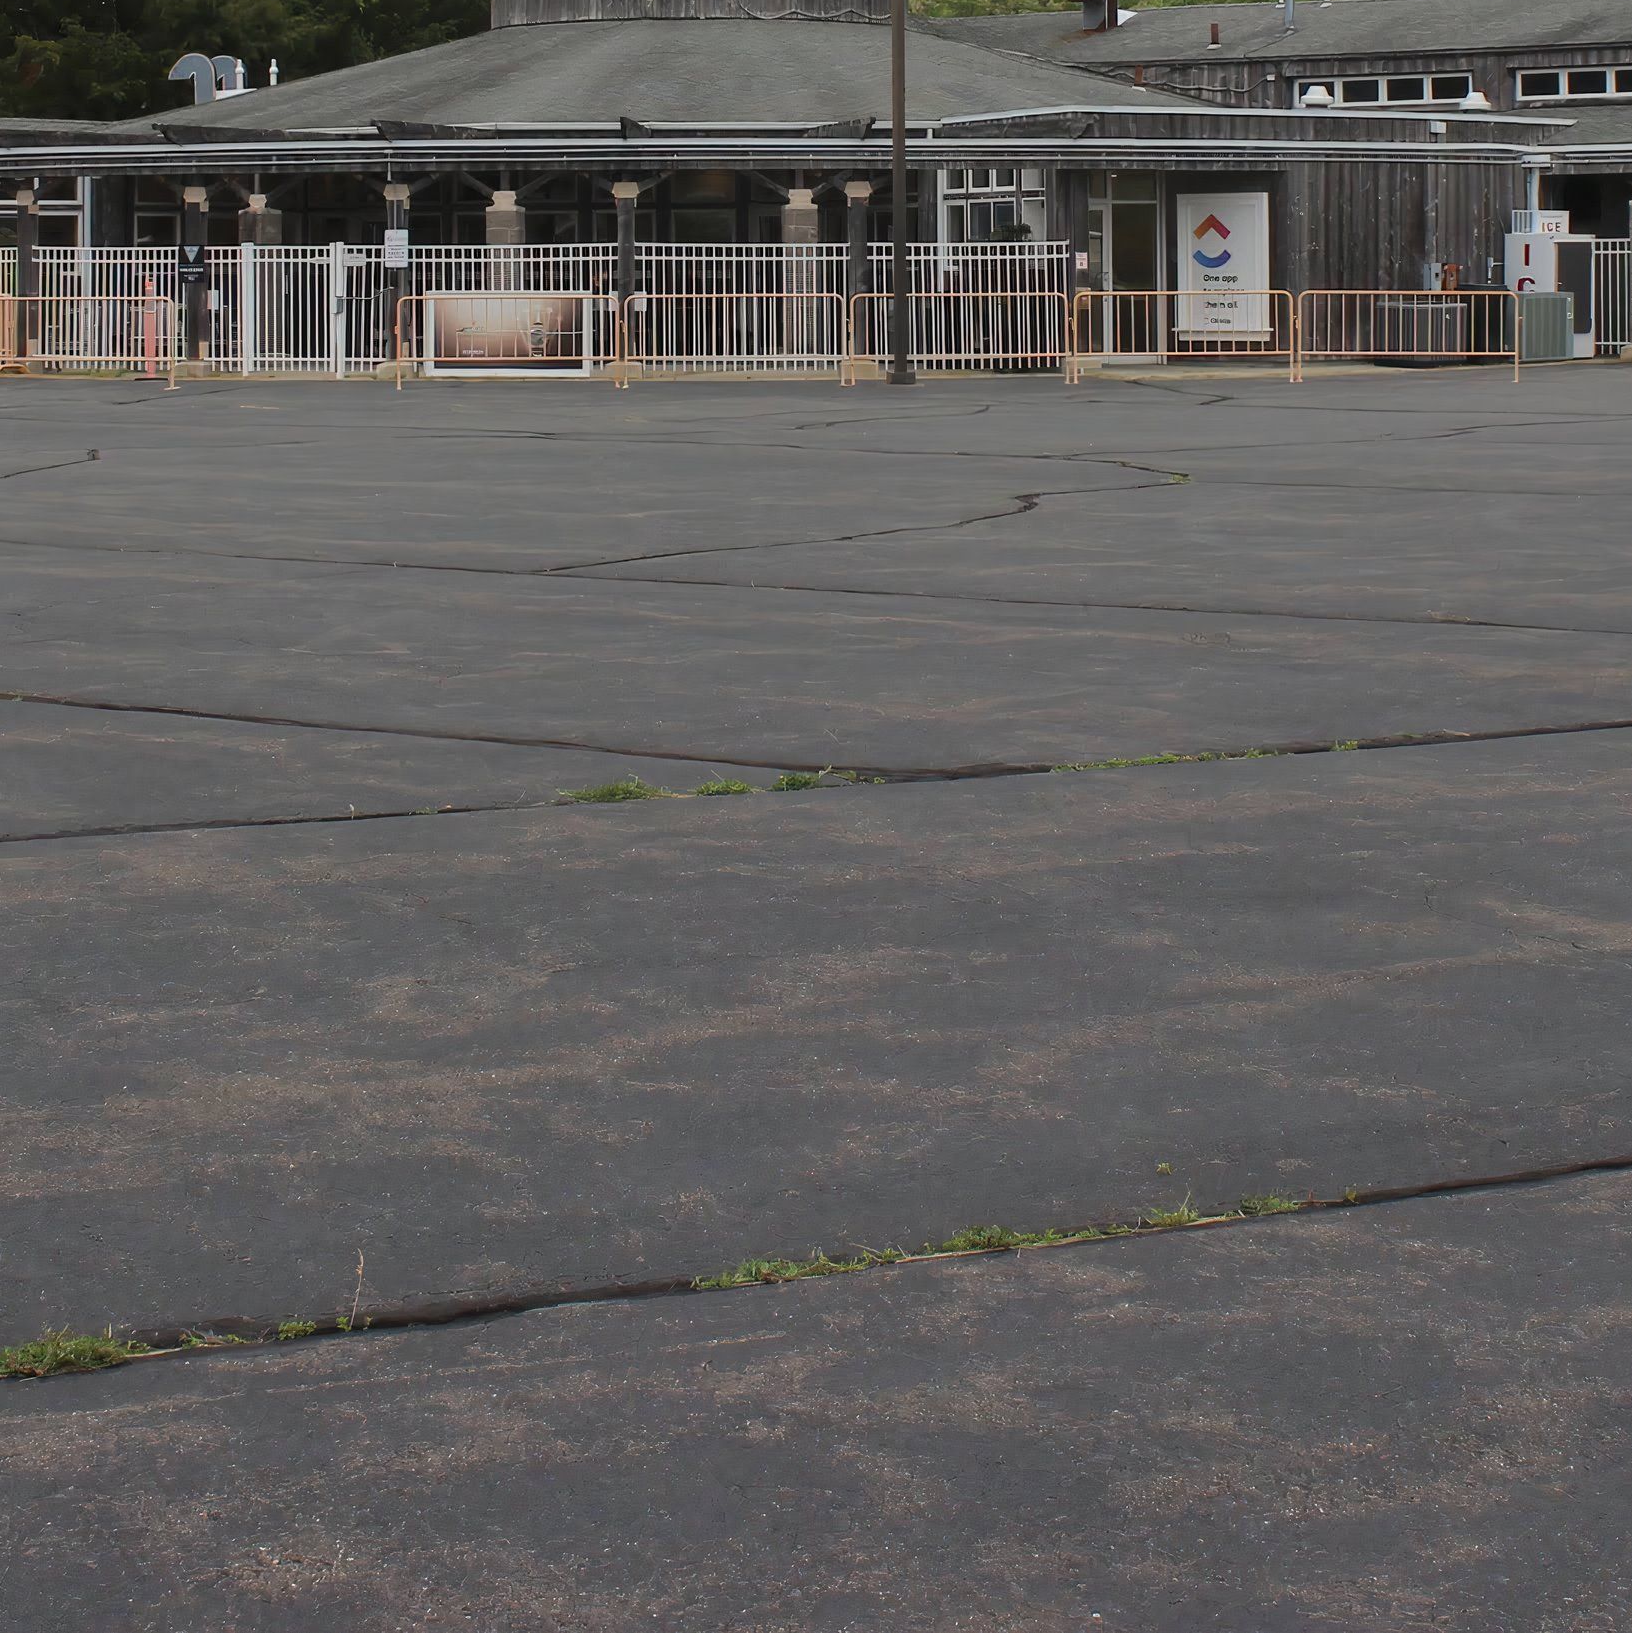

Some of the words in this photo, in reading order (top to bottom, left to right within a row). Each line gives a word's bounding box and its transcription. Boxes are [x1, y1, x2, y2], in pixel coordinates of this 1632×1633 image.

[1541, 222, 1562, 233] ICE
[1517, 243, 1536, 292] IC
[1203, 274, 1219, 282] One
[1222, 275, 1238, 283] app
